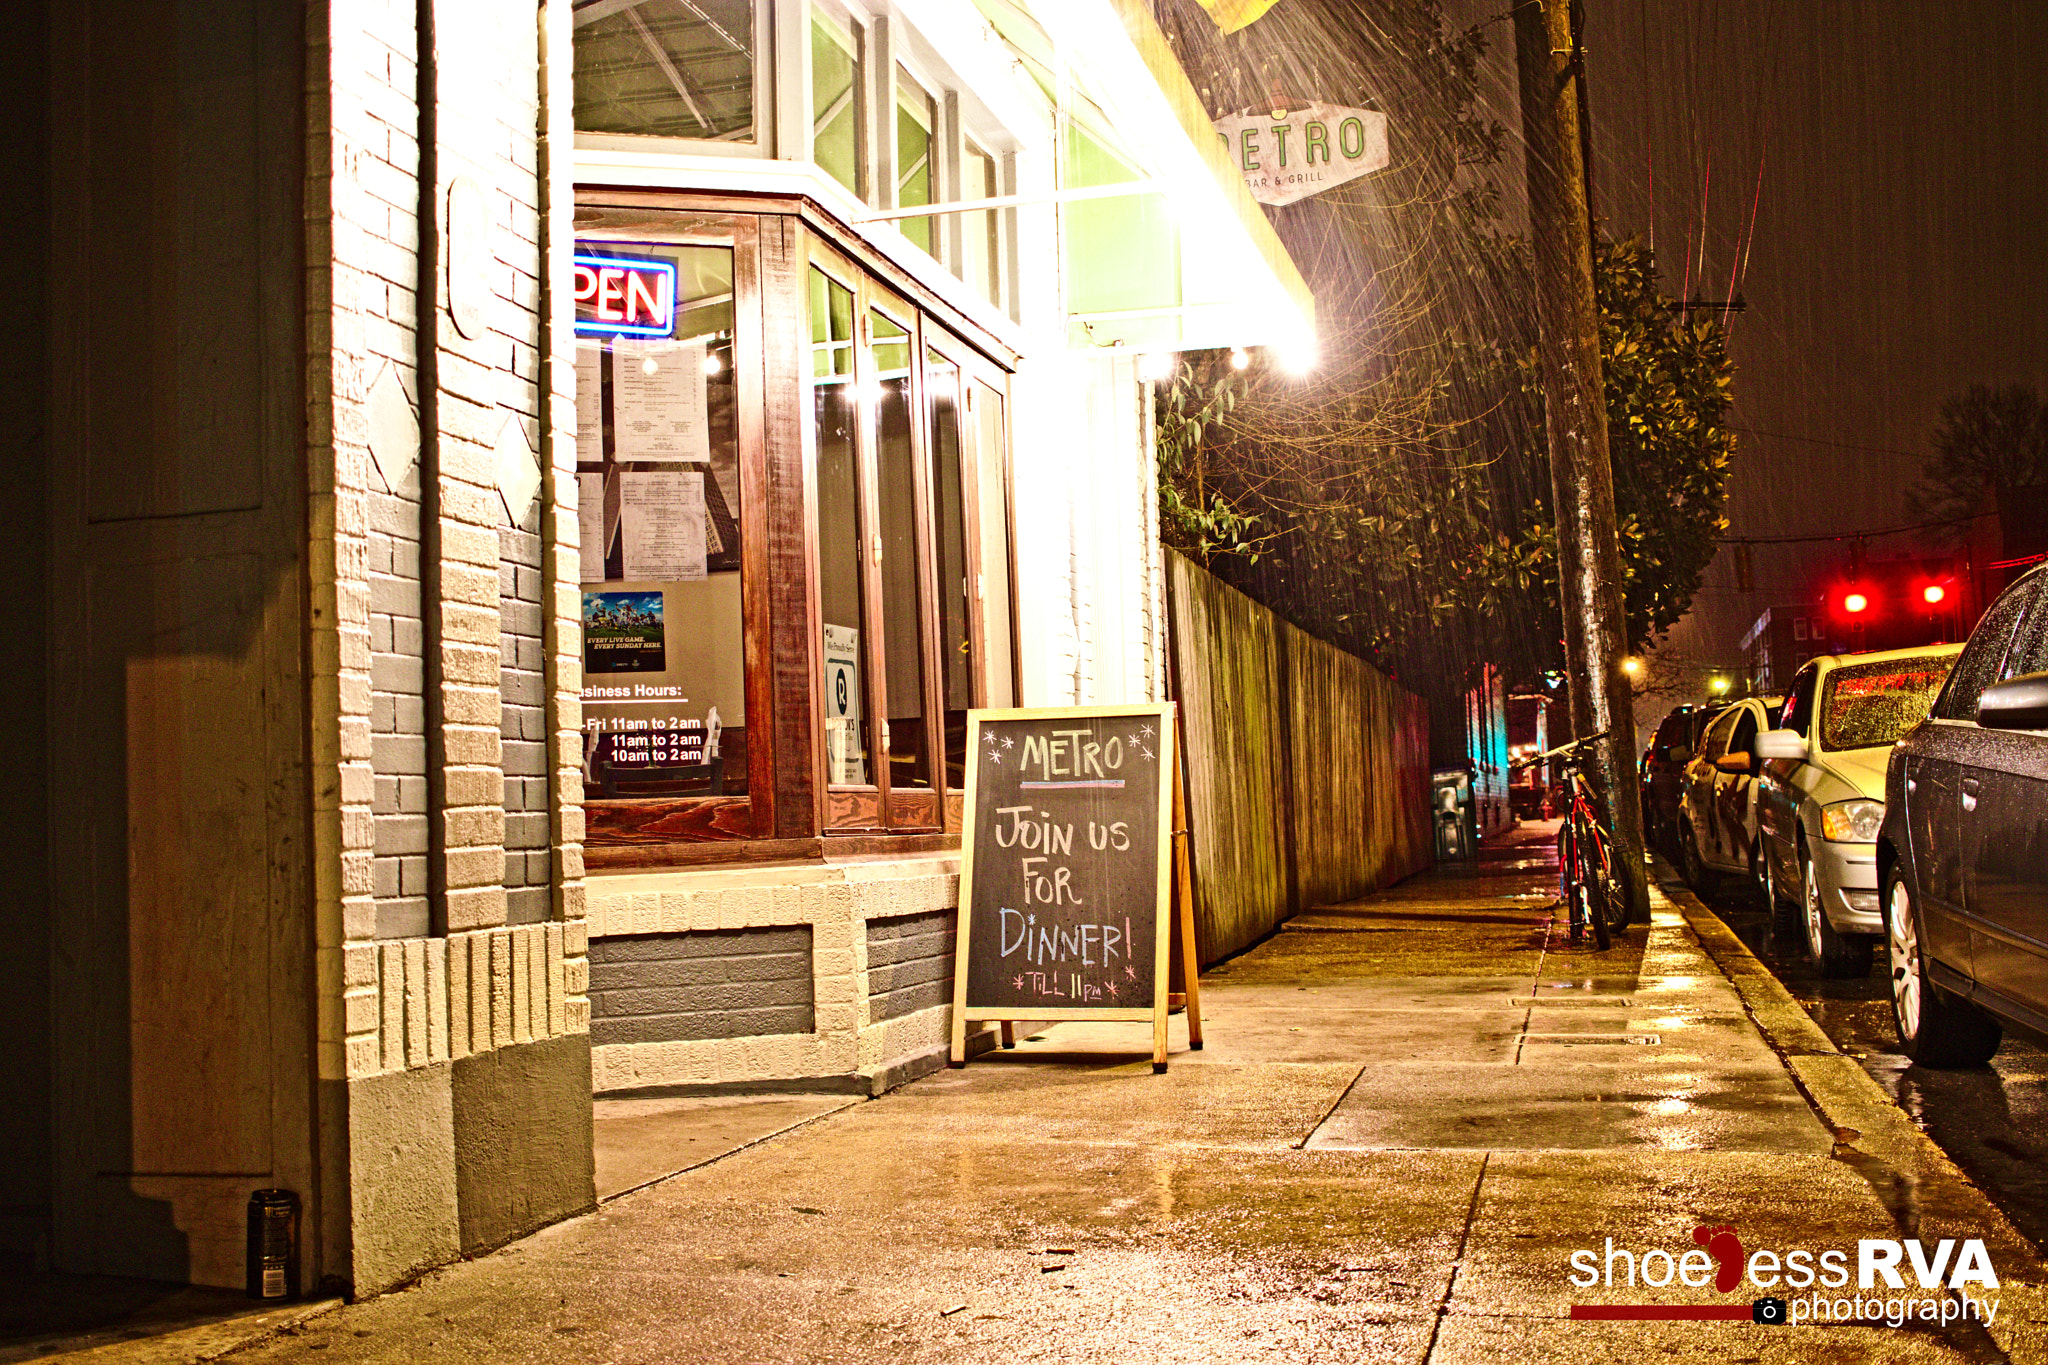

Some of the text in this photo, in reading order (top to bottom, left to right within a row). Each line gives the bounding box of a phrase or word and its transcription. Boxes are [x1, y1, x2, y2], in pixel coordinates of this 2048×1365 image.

[1217, 116, 1365, 172] ETRO
[1288, 172, 1323, 184] GRILL
[634, 684, 682, 697] Hours:
[611, 717, 648, 730] 11am
[652, 718, 665, 730] to
[611, 734, 648, 747] 11am
[652, 735, 666, 747] to
[611, 750, 649, 762] 10am
[653, 750, 666, 762] to
[1020, 729, 1124, 781] METRO
[1022, 856, 1083, 905] FOR
